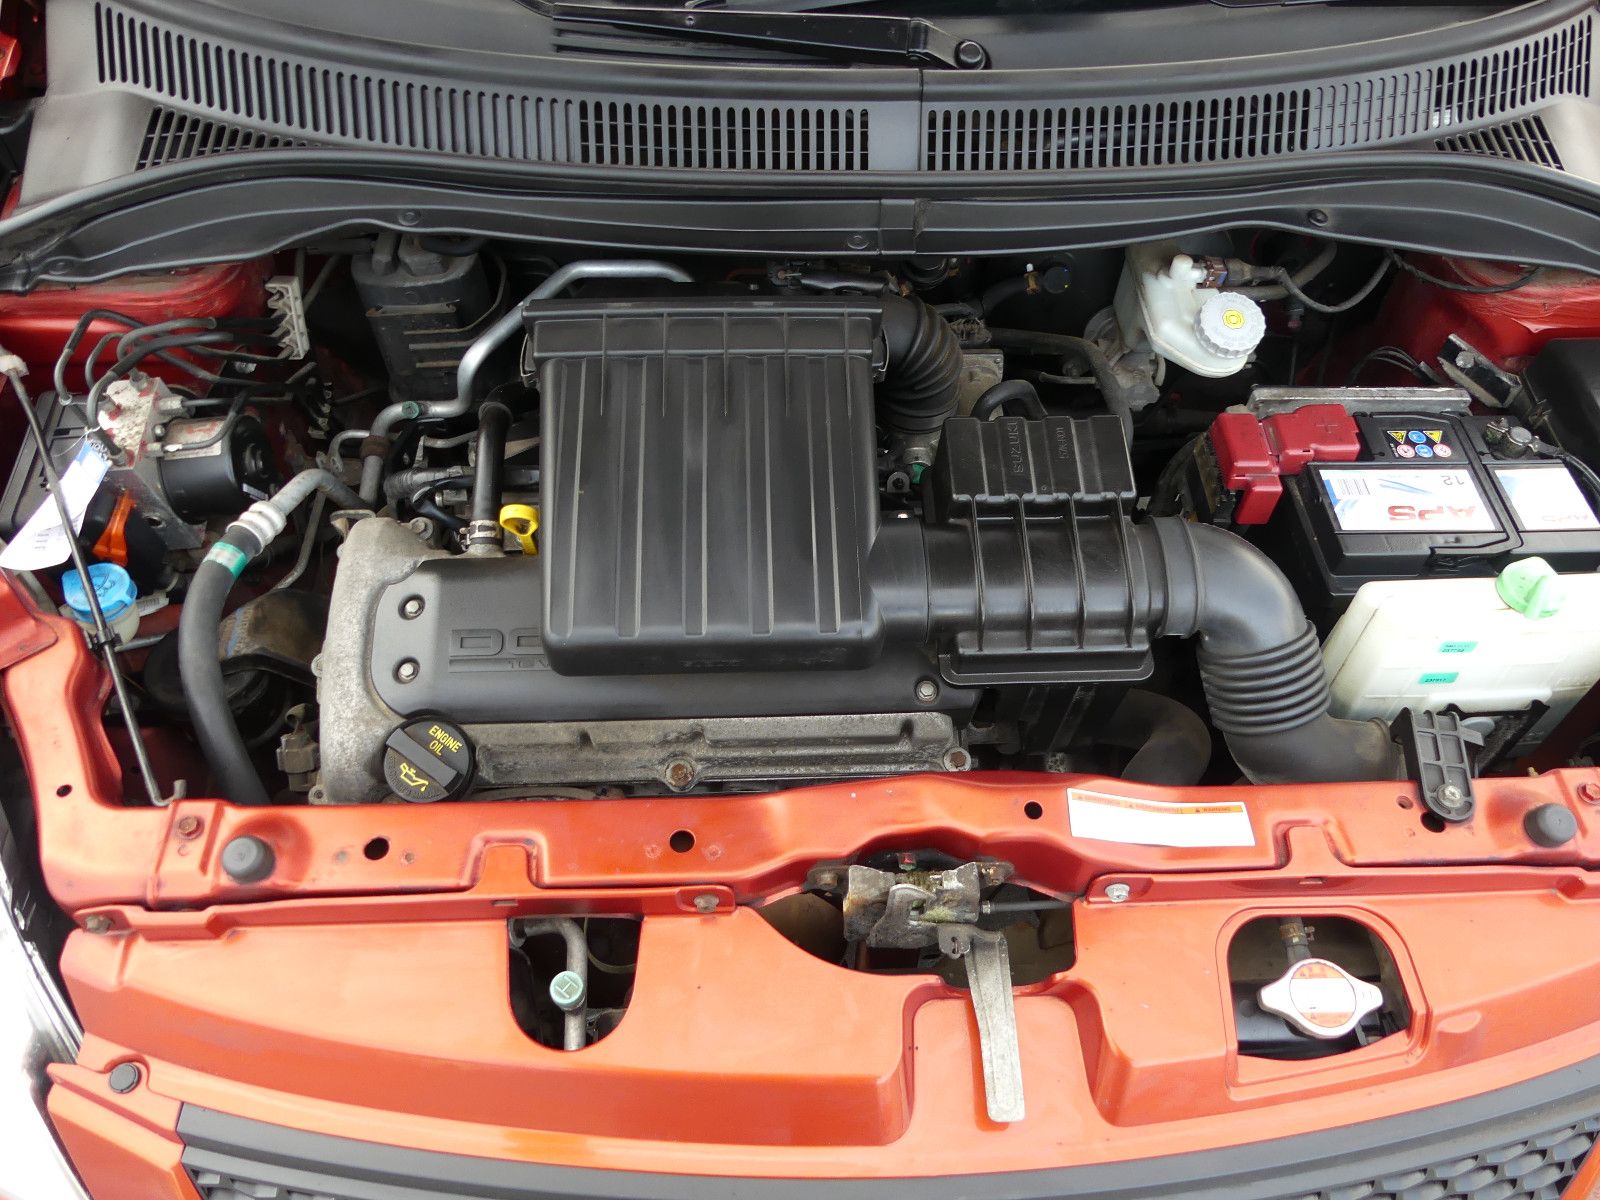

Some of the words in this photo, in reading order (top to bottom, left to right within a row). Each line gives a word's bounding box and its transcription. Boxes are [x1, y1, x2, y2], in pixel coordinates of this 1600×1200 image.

[1007, 421, 1024, 473] SUZUKI
[1440, 475, 1466, 486] 12
[1387, 505, 1476, 522] APS
[427, 724, 463, 753] ENGINE
[429, 740, 445, 756] OIL
